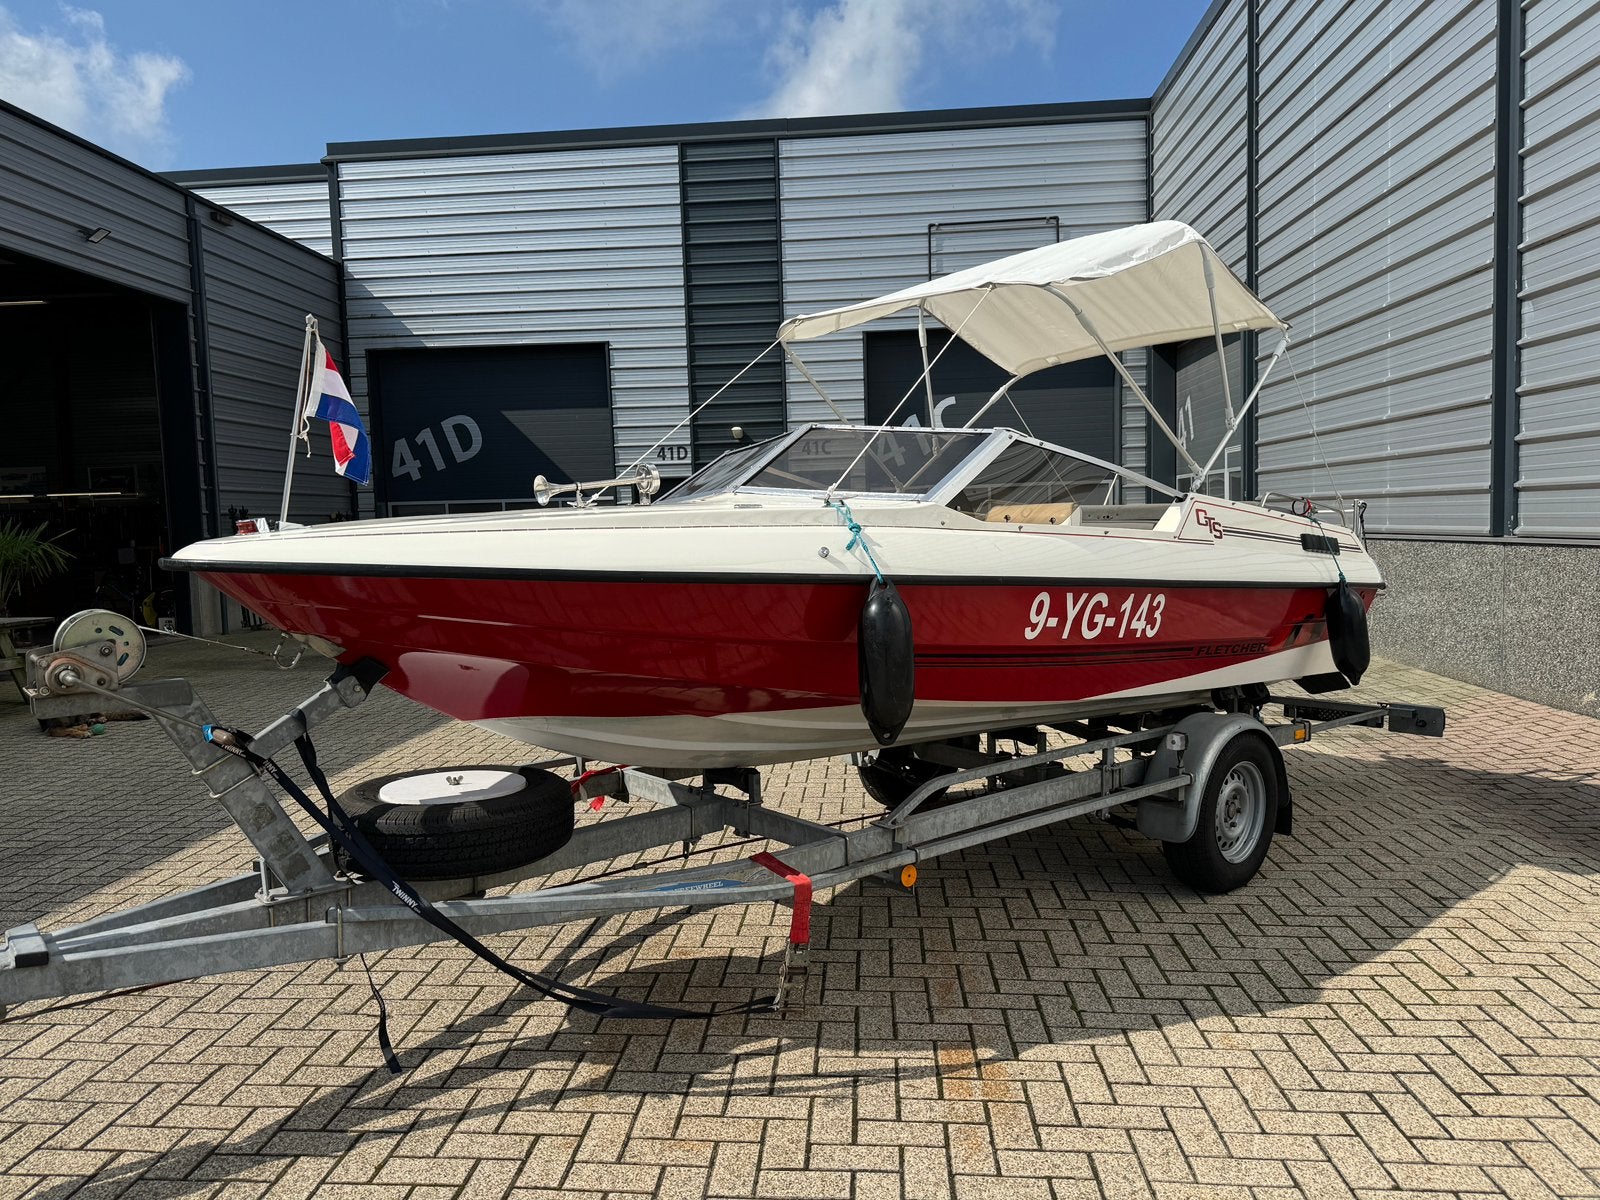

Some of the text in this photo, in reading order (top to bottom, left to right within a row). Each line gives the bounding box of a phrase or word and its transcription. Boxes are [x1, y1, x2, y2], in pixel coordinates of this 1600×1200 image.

[391, 414, 483, 482] 41D
[656, 446, 689, 461] 41D
[802, 440, 832, 455] 41C
[1024, 591, 1166, 640] 9-YG-143
[1197, 642, 1268, 656] FLETCHER
[391, 880, 419, 909] TWINNY
